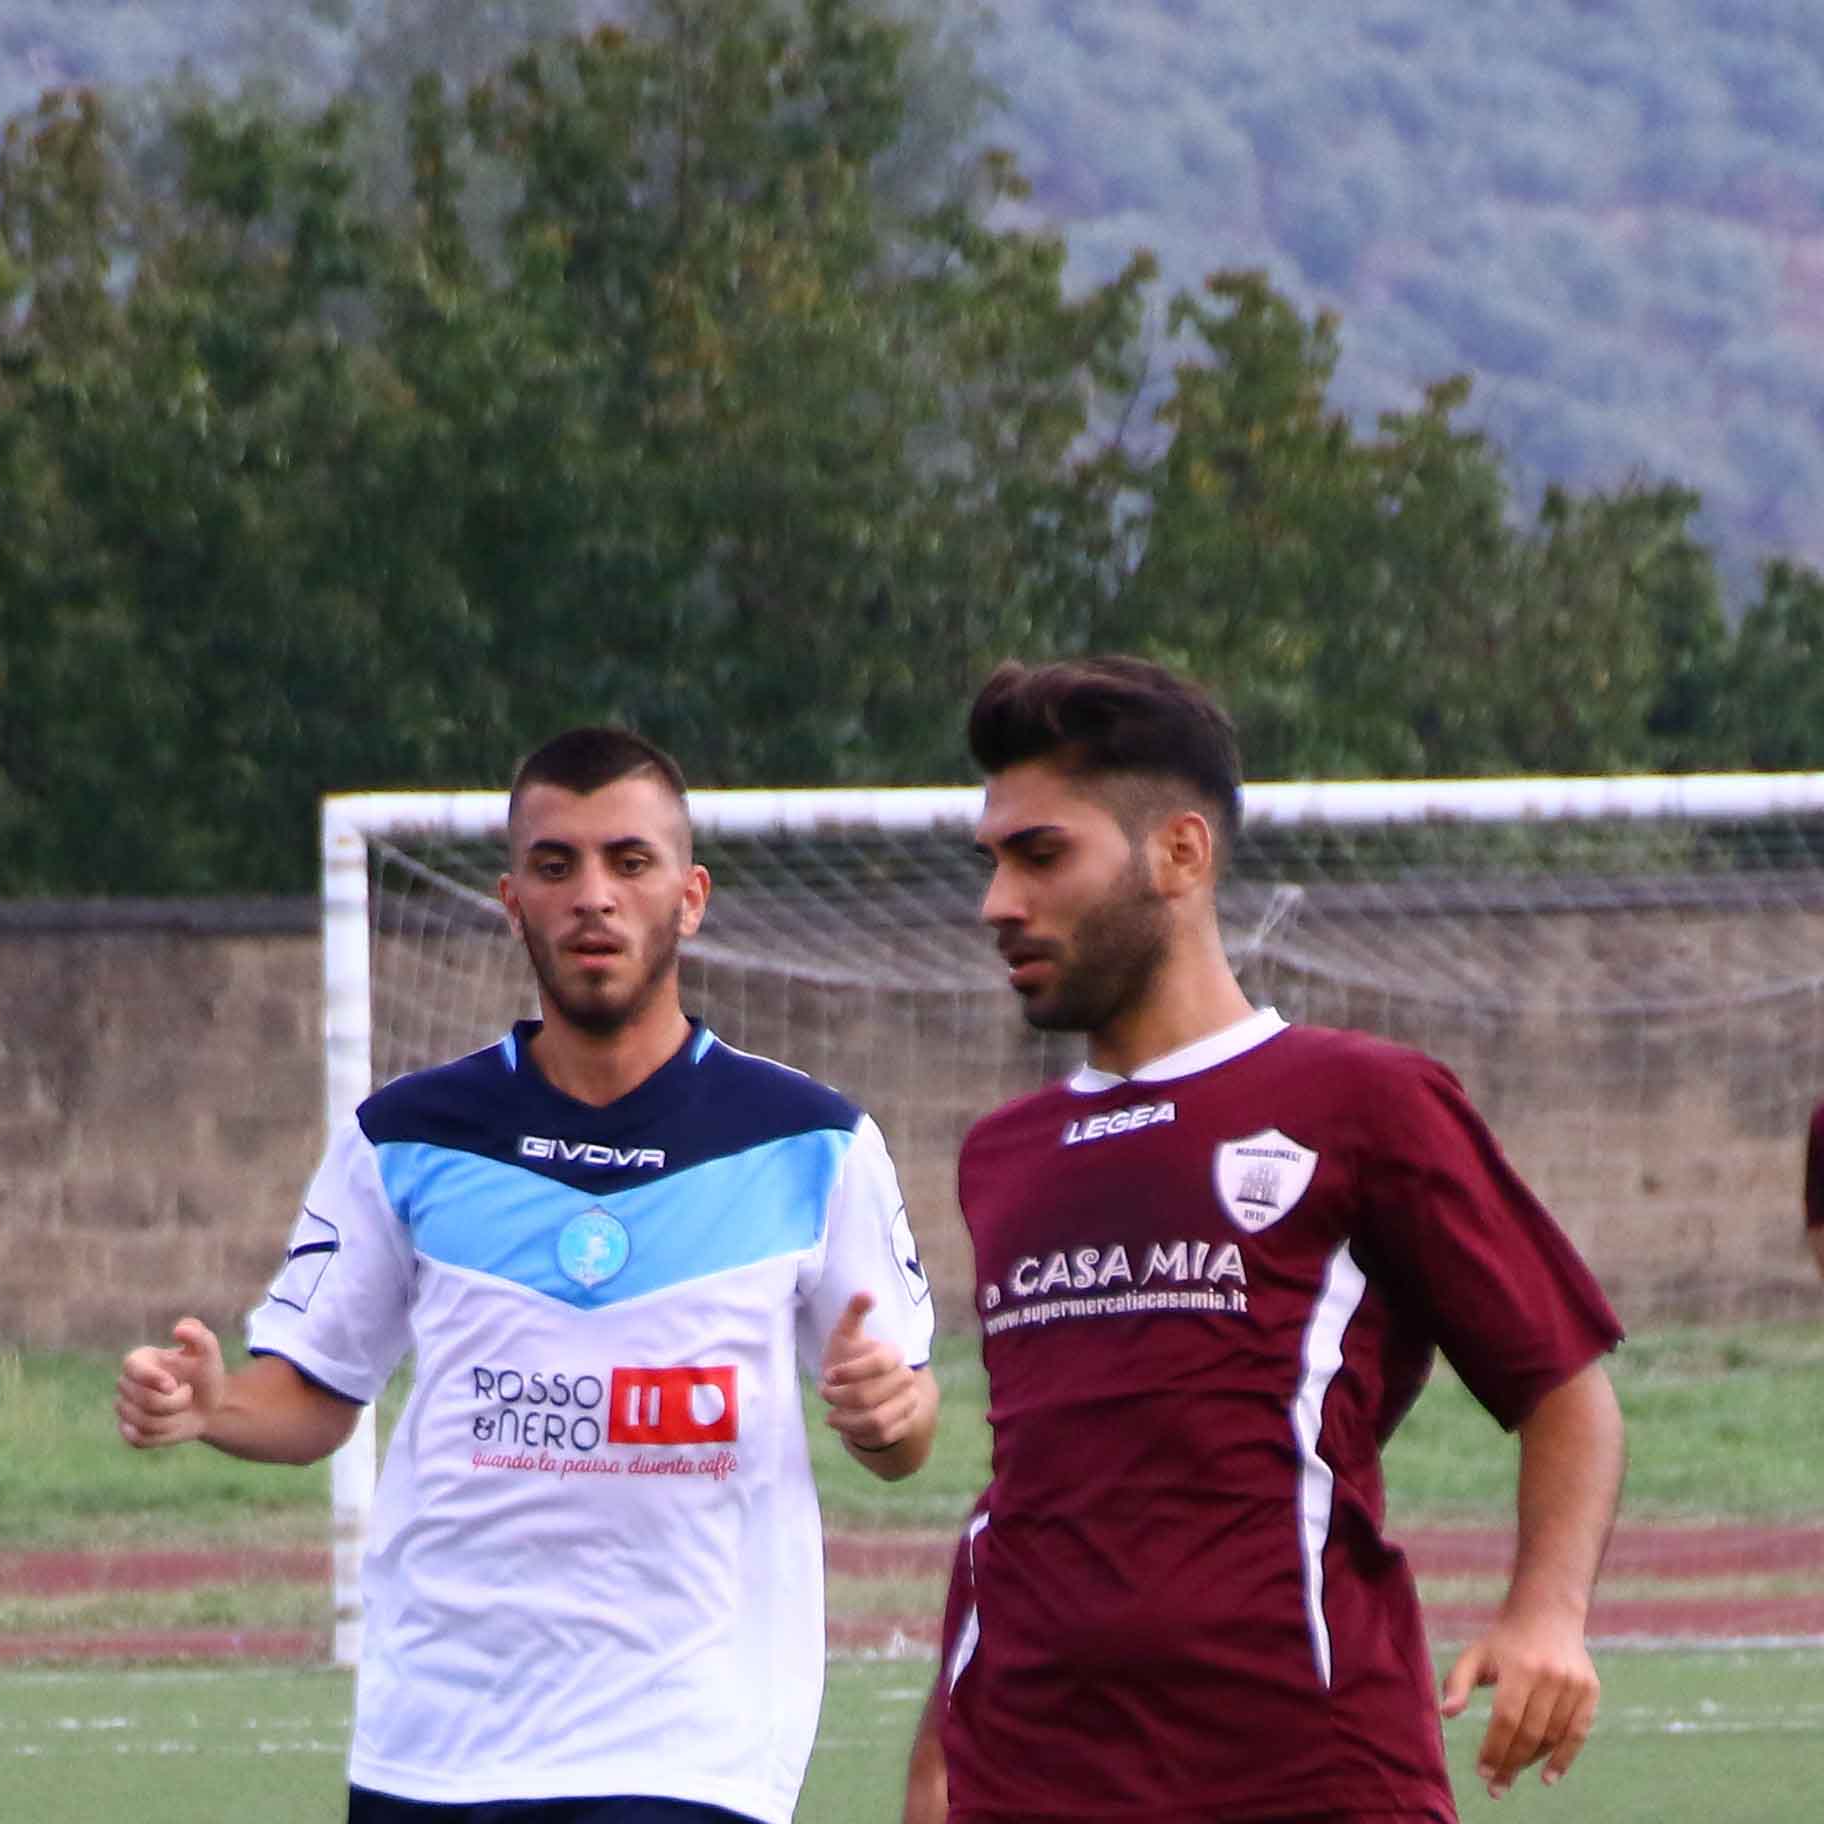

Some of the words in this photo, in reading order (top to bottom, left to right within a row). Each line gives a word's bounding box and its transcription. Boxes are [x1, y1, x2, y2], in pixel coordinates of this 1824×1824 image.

[1065, 1102, 1176, 1145] LEGEA
[521, 1136, 666, 1169] GIVOVA
[1012, 1245, 1133, 1296] CASA
[1141, 1241, 1248, 1287] MIA
[985, 1288, 1249, 1337] www.supermercatiacasamia.it
[473, 1367, 603, 1410] ROSSO
[472, 1452, 534, 1472] quando
[537, 1453, 557, 1473] la
[560, 1457, 620, 1480] pausa
[628, 1454, 694, 1475] diventa
[698, 1452, 737, 1481] caffè
